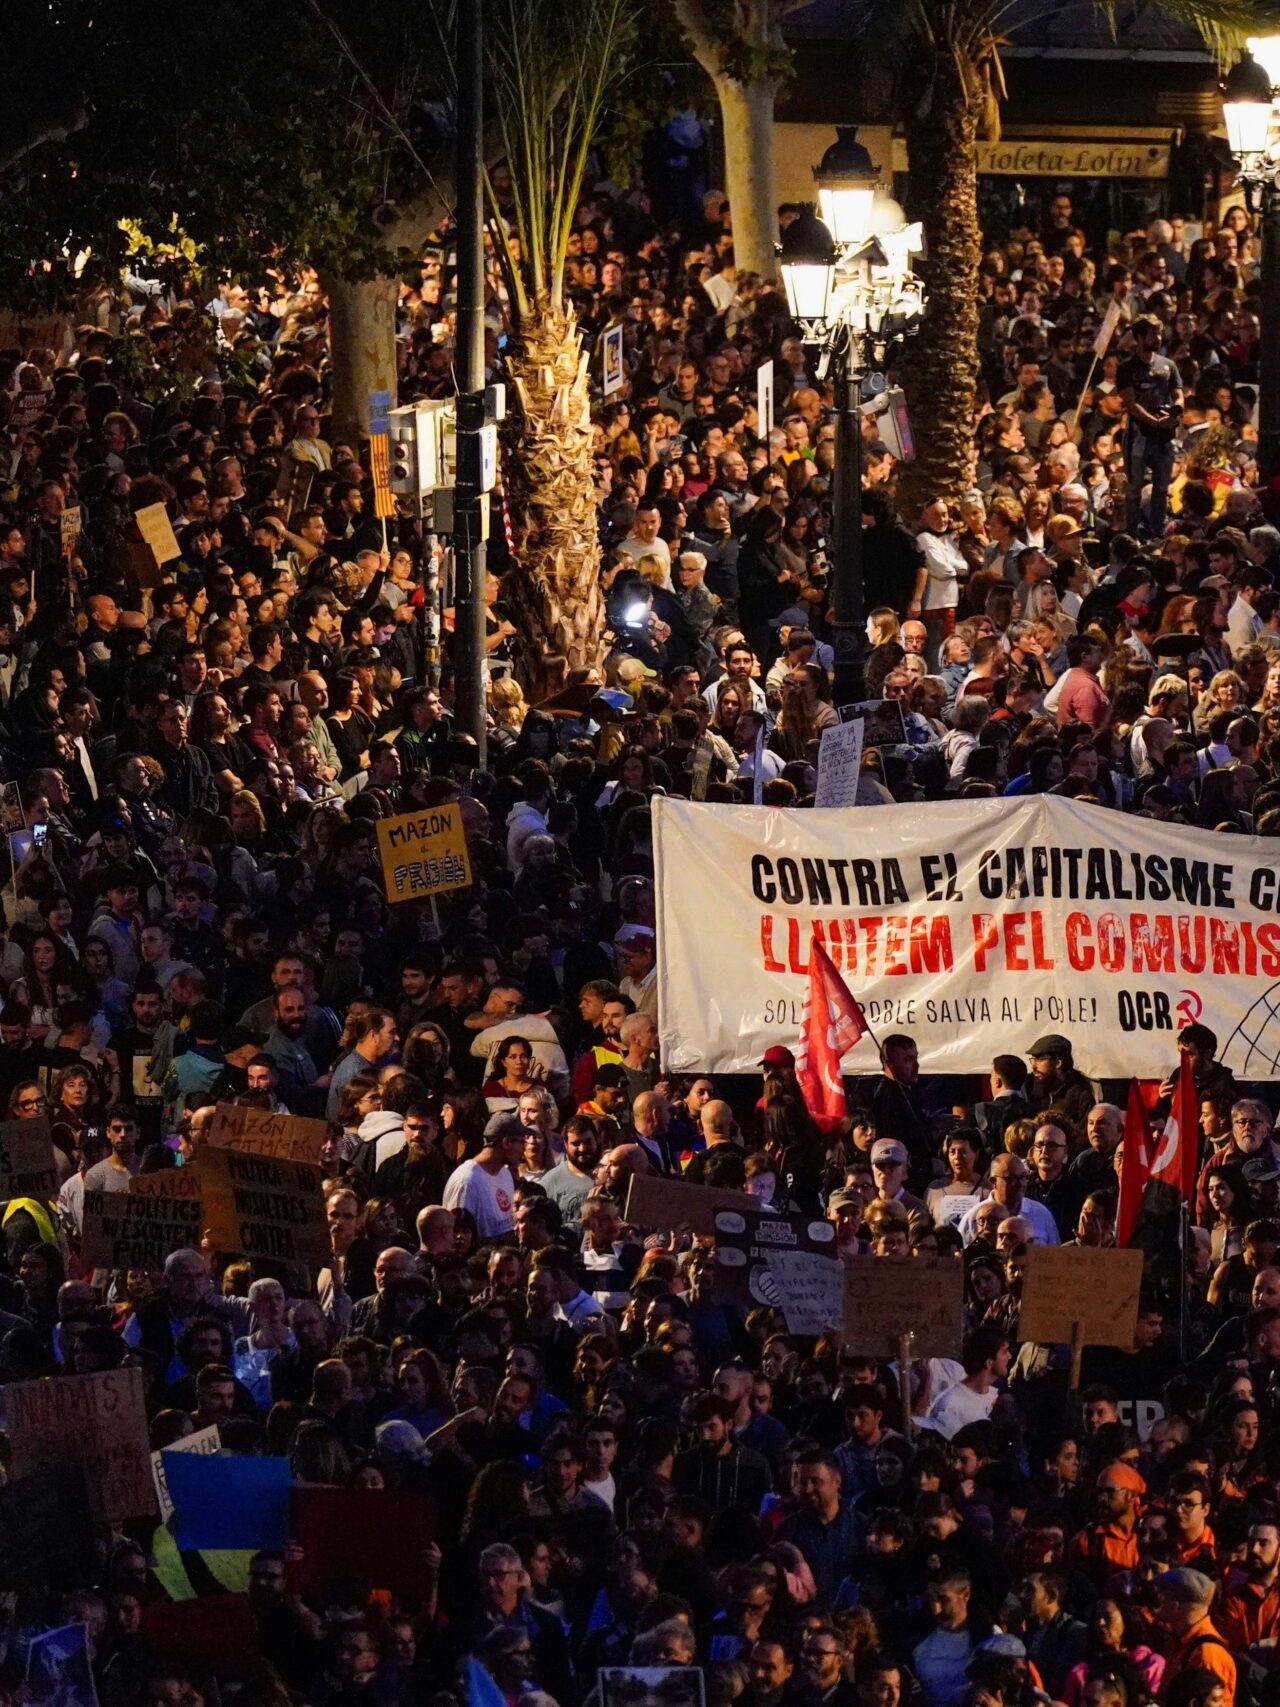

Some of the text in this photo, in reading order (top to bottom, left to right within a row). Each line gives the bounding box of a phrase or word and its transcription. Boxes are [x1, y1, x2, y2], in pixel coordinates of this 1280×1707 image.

[388, 810, 453, 848] MAZÓN
[394, 848, 466, 894] PRISIÓN
[750, 852, 911, 906] CONTRA
[920, 852, 963, 902] EL
[977, 845, 1236, 909] CAPITALISME
[760, 913, 954, 977] LLUITEM
[971, 909, 1055, 974] PEL
[764, 998, 802, 1025] SOL
[926, 998, 992, 1025] SALVA
[1001, 997, 1023, 1023] AL
[1033, 996, 1098, 1024] POBLE!
[1118, 989, 1174, 1032] OCR
